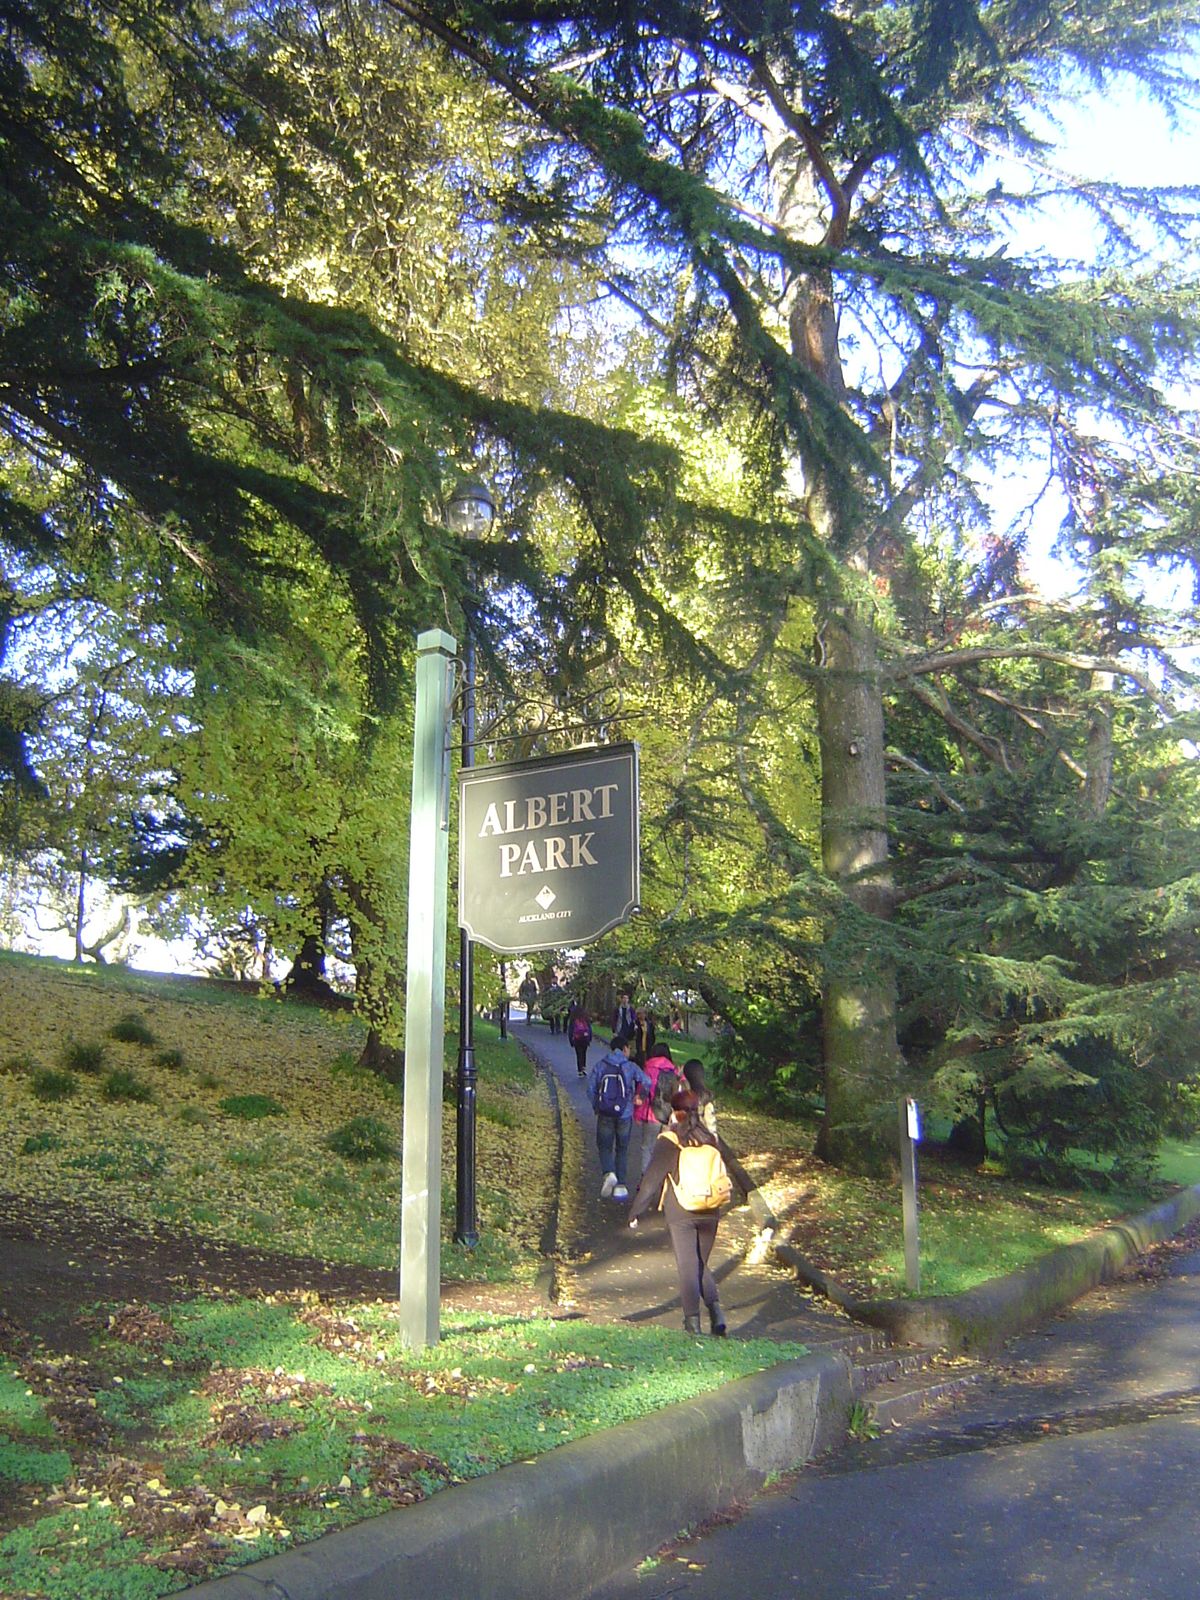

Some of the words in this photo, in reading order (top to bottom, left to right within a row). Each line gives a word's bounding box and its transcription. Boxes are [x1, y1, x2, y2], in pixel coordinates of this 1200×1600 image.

[478, 784, 618, 838] ALBERT
[499, 832, 598, 878] PARK
[519, 912, 555, 923] AUCKLAND
[556, 910, 572, 919] CITY
